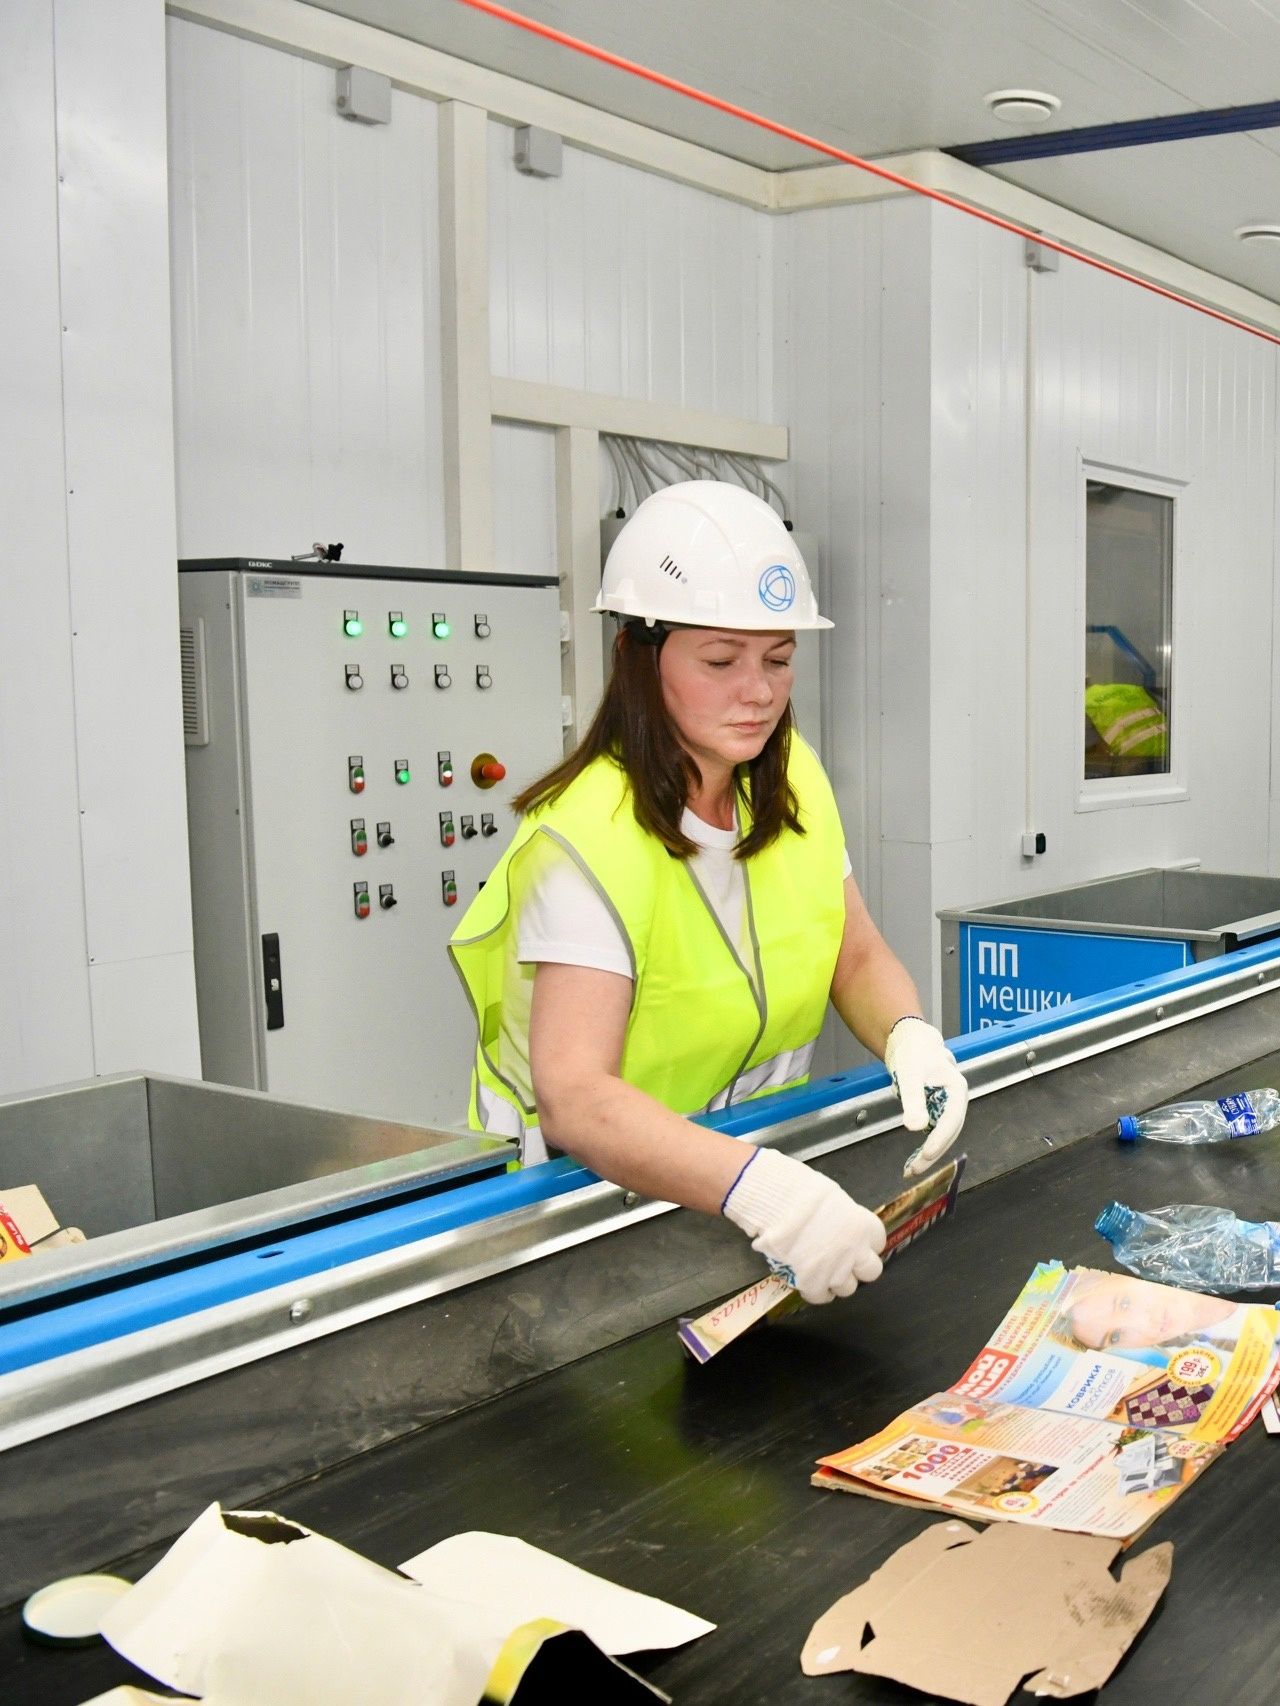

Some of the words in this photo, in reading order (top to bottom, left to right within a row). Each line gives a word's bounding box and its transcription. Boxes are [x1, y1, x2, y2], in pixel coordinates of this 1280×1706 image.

[978, 941, 1018, 978] ПП
[979, 984, 1071, 1014] мешки
[1066, 1364, 1102, 1409] КОВРИКИ
[1179, 1361, 1197, 1377] 199
[902, 1445, 960, 1480] 1000
